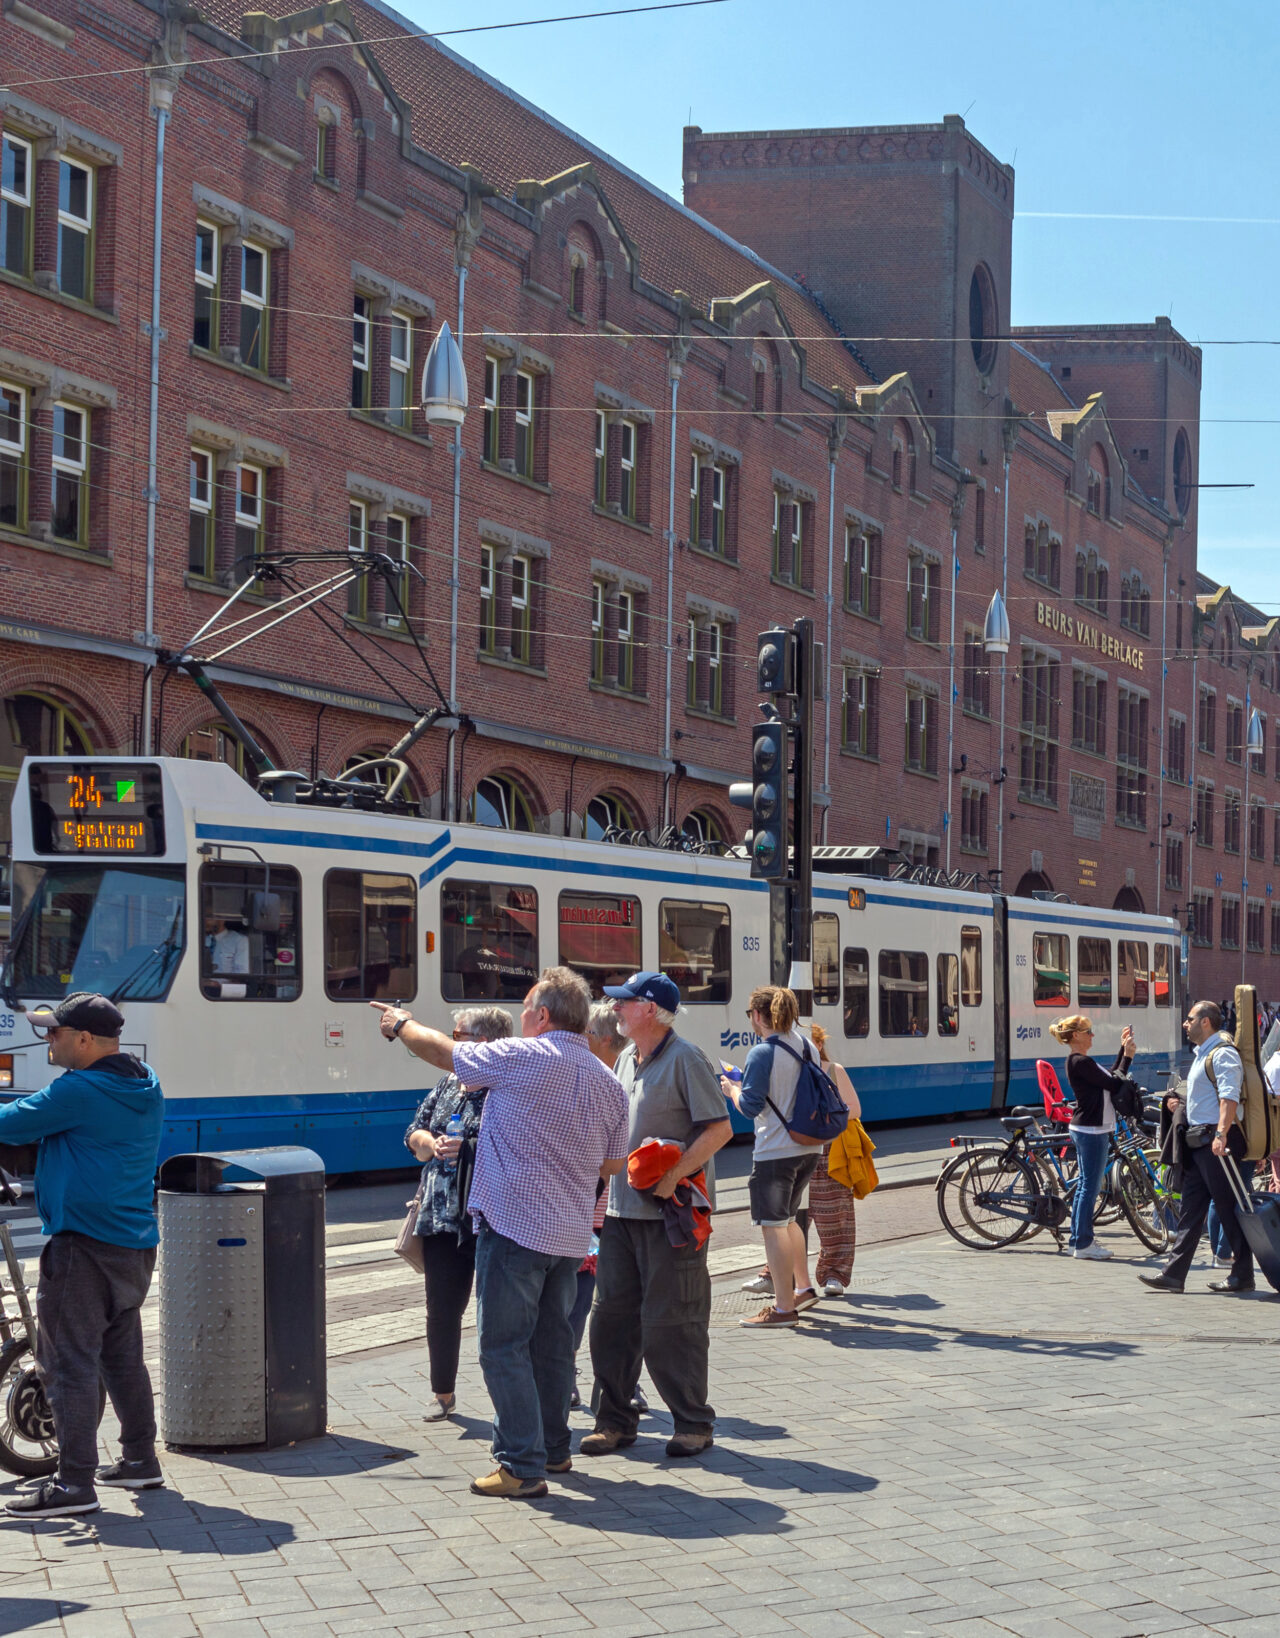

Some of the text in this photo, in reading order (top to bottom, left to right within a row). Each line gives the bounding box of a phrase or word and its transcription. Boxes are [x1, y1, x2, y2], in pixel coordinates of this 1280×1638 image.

[1037, 601, 1143, 671] BEURS VAN BERLAGE
[296, 687, 314, 697] YORK
[316, 690, 331, 700] FILM
[364, 700, 380, 711] CAFE
[66, 775, 104, 808] 24
[64, 821, 144, 836] Centraal
[74, 834, 135, 848] Station
[850, 888, 860, 908] 24
[742, 936, 760, 951] 835
[1016, 954, 1027, 967] 835
[1028, 1027, 1042, 1038] GVB
